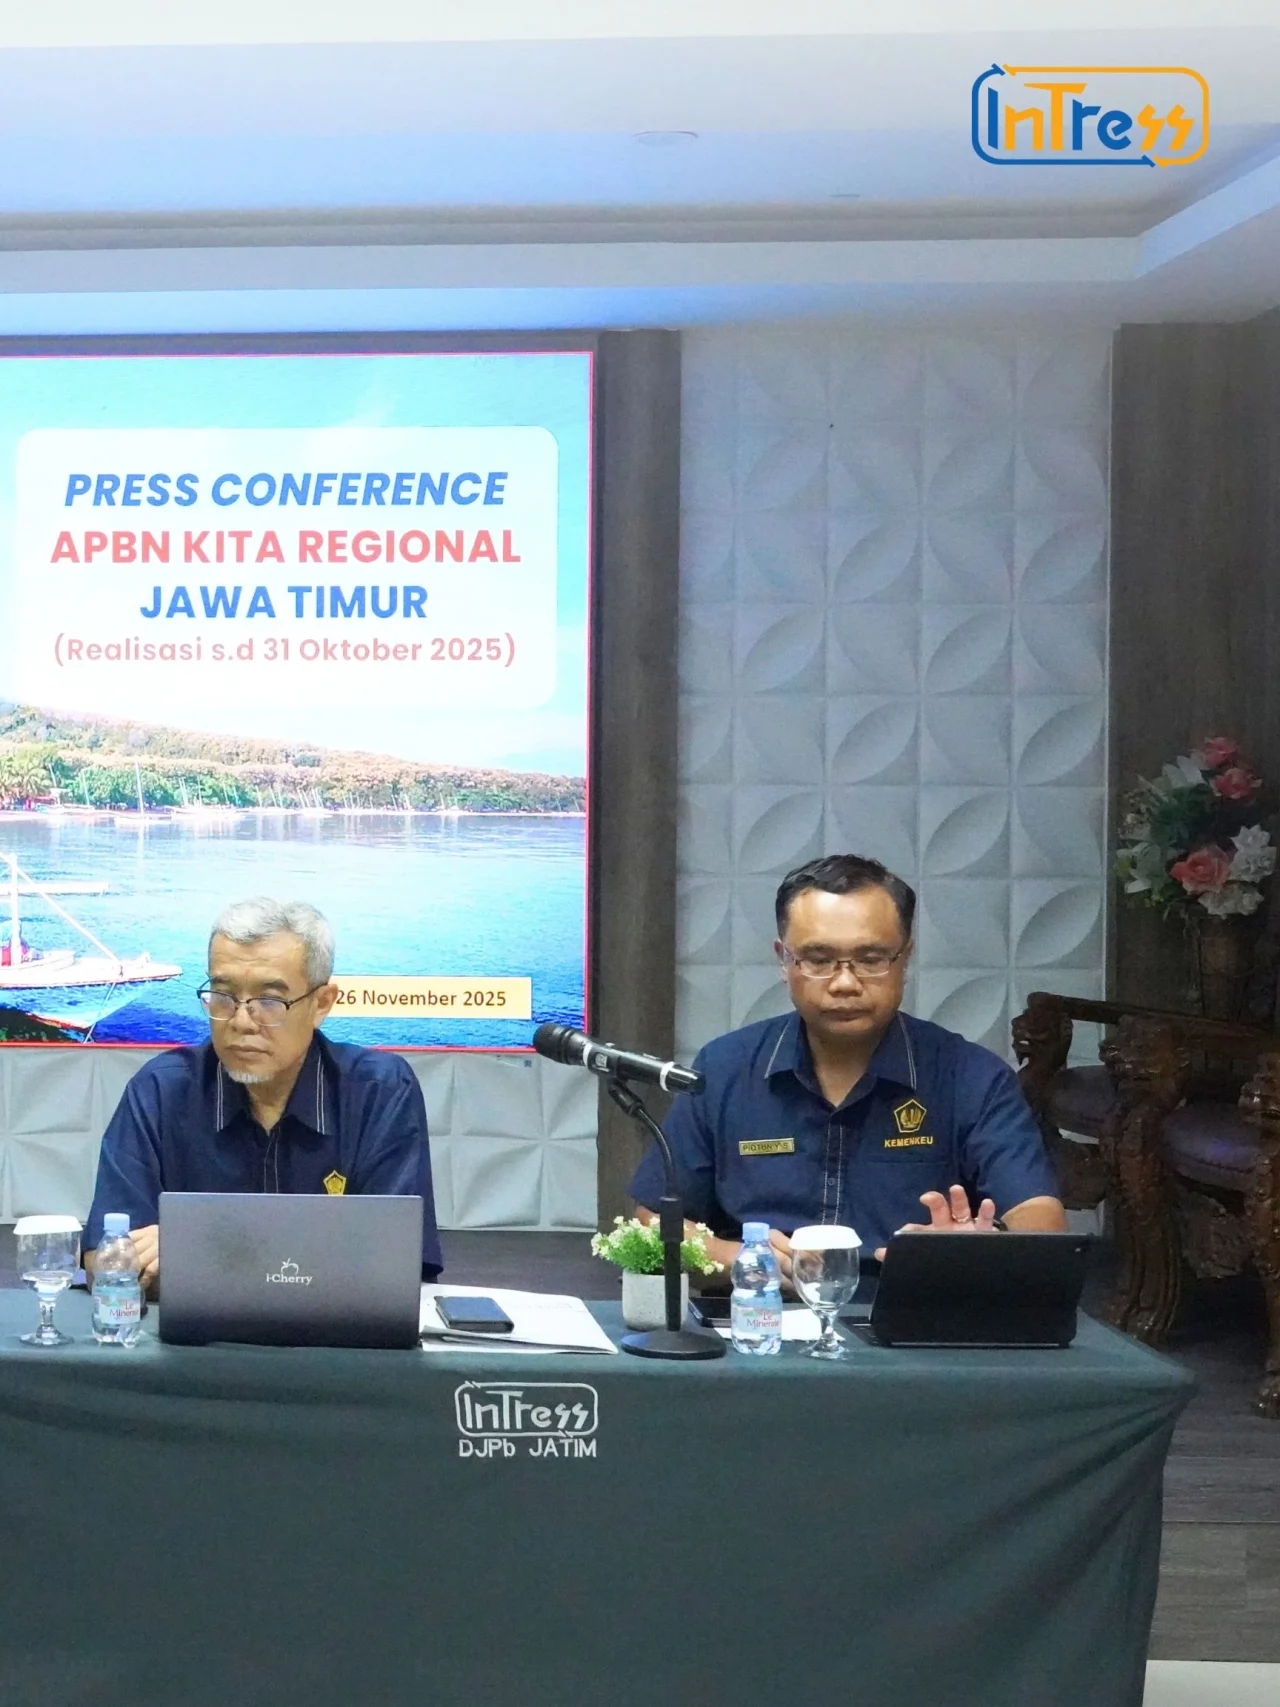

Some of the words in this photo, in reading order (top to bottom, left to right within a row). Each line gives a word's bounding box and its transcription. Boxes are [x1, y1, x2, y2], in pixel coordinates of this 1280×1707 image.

[64, 473, 200, 507] PRESS
[211, 472, 509, 506] CONFERENCE
[50, 530, 170, 563] APBN
[184, 530, 286, 563] KITA
[299, 530, 521, 563] REGIONAL
[140, 586, 276, 618] JAWA
[288, 586, 428, 618] TIMUR
[54, 633, 202, 667] (Realisasi
[211, 637, 254, 661] s.d
[263, 638, 289, 661] 31
[299, 637, 422, 661] Oktober
[430, 632, 516, 667] 2025)
[336, 989, 357, 1005] 26
[363, 989, 457, 1006] November
[463, 990, 507, 1006] 2025
[884, 1136, 934, 1148] KEMENKEU
[458, 1438, 516, 1458] DJPb
[528, 1437, 597, 1458] JATIM
